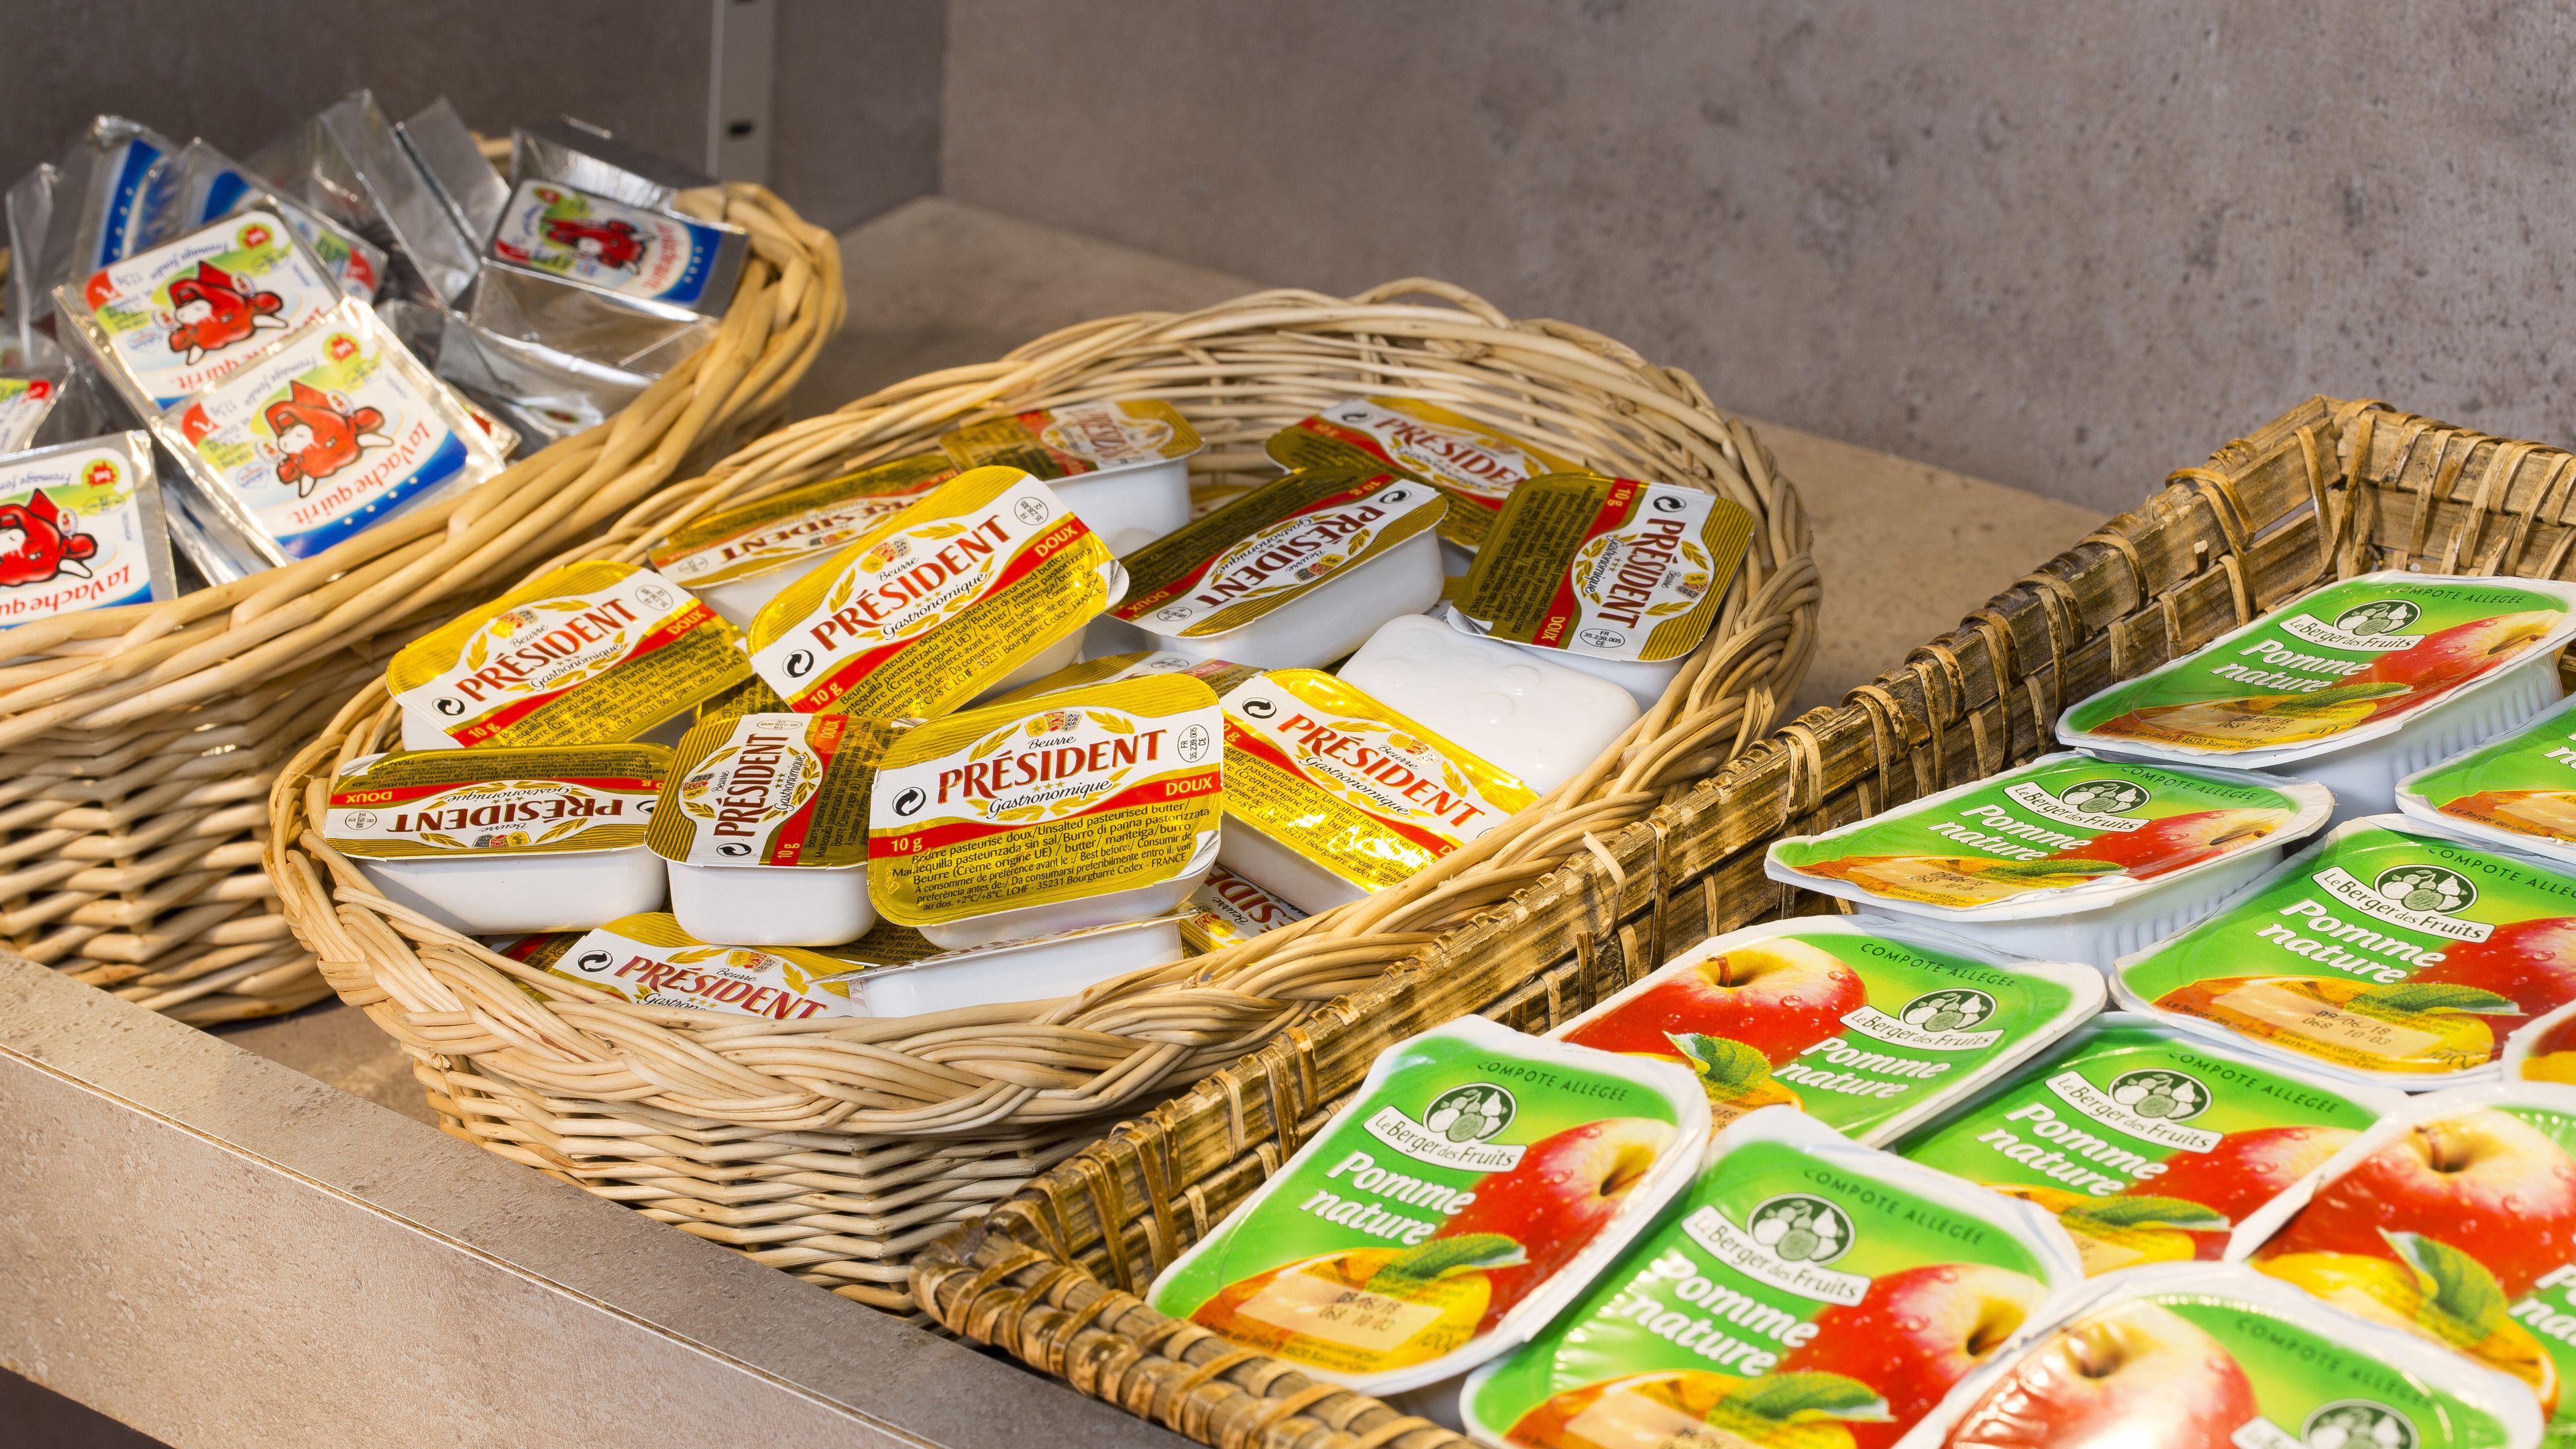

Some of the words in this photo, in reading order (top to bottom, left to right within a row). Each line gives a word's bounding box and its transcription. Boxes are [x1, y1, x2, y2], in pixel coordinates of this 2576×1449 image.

[1375, 417, 1527, 486] PRÉSIDE
[321, 486, 353, 515] qui
[1615, 488, 1631, 499] 10
[877, 556, 920, 582] Beurre
[1195, 505, 1387, 608] PRÉSIDENT
[1215, 515, 1313, 577] Gastronomique
[1285, 550, 1326, 573] Beurre
[1585, 535, 1625, 594] Gastronomique
[30, 580, 105, 611] Vache
[808, 515, 1013, 652] PRÉSIDENT
[1597, 518, 1686, 629] PRÉSIDENT
[0, 599, 25, 616] qu
[666, 610, 708, 636] DOUX
[810, 689, 829, 707] 10
[832, 682, 844, 698] g
[1034, 525, 1078, 558] DOUX
[881, 572, 989, 641] Gastronomique
[1132, 590, 1170, 613] DOUX
[455, 598, 640, 702] PRÉSIDENT
[508, 623, 549, 649] Beurre
[1542, 616, 1566, 641] DOUX
[1584, 633, 1622, 644] 35.239.005
[2290, 619, 2304, 629] Le
[2302, 623, 2345, 646] Berger
[2344, 638, 2363, 648] des
[2365, 637, 2416, 649] Fruits
[530, 642, 623, 692] Gastronomique
[2210, 662, 2334, 694] nature
[2239, 638, 2375, 677] Pomme
[820, 720, 841, 739] DOUX
[1028, 735, 1077, 750] Beurre
[937, 729, 1168, 805] PRÉSIDENT
[1276, 712, 1486, 830] PRÉSIDENT
[1379, 743, 1419, 770] Beurre
[345, 791, 394, 804] DOUX
[444, 785, 574, 804] Gastronomique
[712, 770, 730, 793] Beurre
[713, 733, 790, 837] PRÉSIDENT
[774, 753, 806, 812] Gastronomique
[986, 780, 1113, 820] Gastronomique
[1298, 756, 1411, 816] Gastronomique
[386, 795, 623, 834] PRÉSIDENT
[479, 822, 527, 833] Beurre
[891, 838, 908, 853] 10
[912, 837, 923, 852] g
[1165, 775, 1214, 798] DOUX
[950, 836, 1004, 859] pasteurisé
[1006, 818, 1083, 843] doux/Unsalted
[1087, 806, 1148, 829] pasteurised
[1151, 798, 1191, 814] butter/
[1960, 803, 2094, 851] Pomme
[2015, 786, 2029, 798] Le
[2027, 792, 2068, 820] Berger
[2067, 810, 2083, 822] des
[2082, 814, 2139, 832] Fruits
[914, 871, 950, 885] Beurre
[953, 863, 992, 879] (Crème
[995, 853, 1032, 871] origine
[1105, 823, 1192, 845] manteiga/burro
[956, 844, 1022, 869] pasteurizada
[1042, 830, 1094, 848] sal/Burro
[1110, 819, 1142, 835] panna
[1145, 808, 1210, 826] pastorizzata
[1927, 820, 2051, 862] nature
[924, 877, 975, 894] consommer
[1036, 857, 1059, 870] avant
[1080, 847, 1099, 862] Best
[1137, 834, 1180, 849] Consumir
[967, 885, 989, 896] antes
[1025, 867, 1075, 883] consumarsi
[1076, 854, 1139, 874] preferibilmente
[1141, 848, 1165, 859] entro
[1176, 841, 1194, 853] voir
[1006, 885, 1030, 896] LCHF
[1036, 879, 1065, 891] 35231
[1117, 863, 1144, 875] Cedex
[1151, 852, 1187, 869] FRANCE
[1212, 896, 1248, 925] Beurre
[2324, 872, 2340, 887] Le
[2336, 881, 2399, 915] Berger
[2394, 909, 2419, 924] des
[2419, 916, 2485, 940] Fruits
[2525, 877, 2576, 899] ALLÉ
[2254, 922, 2408, 985] nature
[2278, 898, 2447, 968] Pomme
[716, 967, 758, 982] Beurre
[1861, 943, 1945, 973] COMPOTE
[614, 954, 829, 1020] PRÉSIDENT
[637, 993, 706, 1010] Gastron
[1851, 1012, 1866, 1022] Le
[1862, 1014, 1916, 1041] Berger
[1915, 1032, 1934, 1045] des
[1935, 1033, 1992, 1048] Fruits
[1477, 1061, 1557, 1087] COMPOTE
[1770, 1063, 1910, 1099] nature
[1799, 1036, 1952, 1079] Pomme
[2057, 1078, 2073, 1092] Le
[2070, 1084, 2128, 1128] Berger
[2126, 1117, 2149, 1132] des
[2147, 1122, 2212, 1150] Fruits
[1375, 1115, 1390, 1130] Le
[1389, 1120, 1438, 1156] Berger
[1438, 1146, 1456, 1161] des
[1458, 1146, 1516, 1168] Fruits
[1975, 1128, 2127, 1197] nature
[2003, 1101, 2169, 1181] Pomme
[1326, 1150, 1477, 1216] Pomme
[1299, 1189, 1437, 1246] nature
[1708, 1223, 1769, 1273] Berger
[1768, 1263, 1792, 1281] des
[1792, 1269, 1860, 1302] Fruits
[1656, 1248, 1821, 1348] Pomme
[1620, 1293, 1778, 1378] nature
